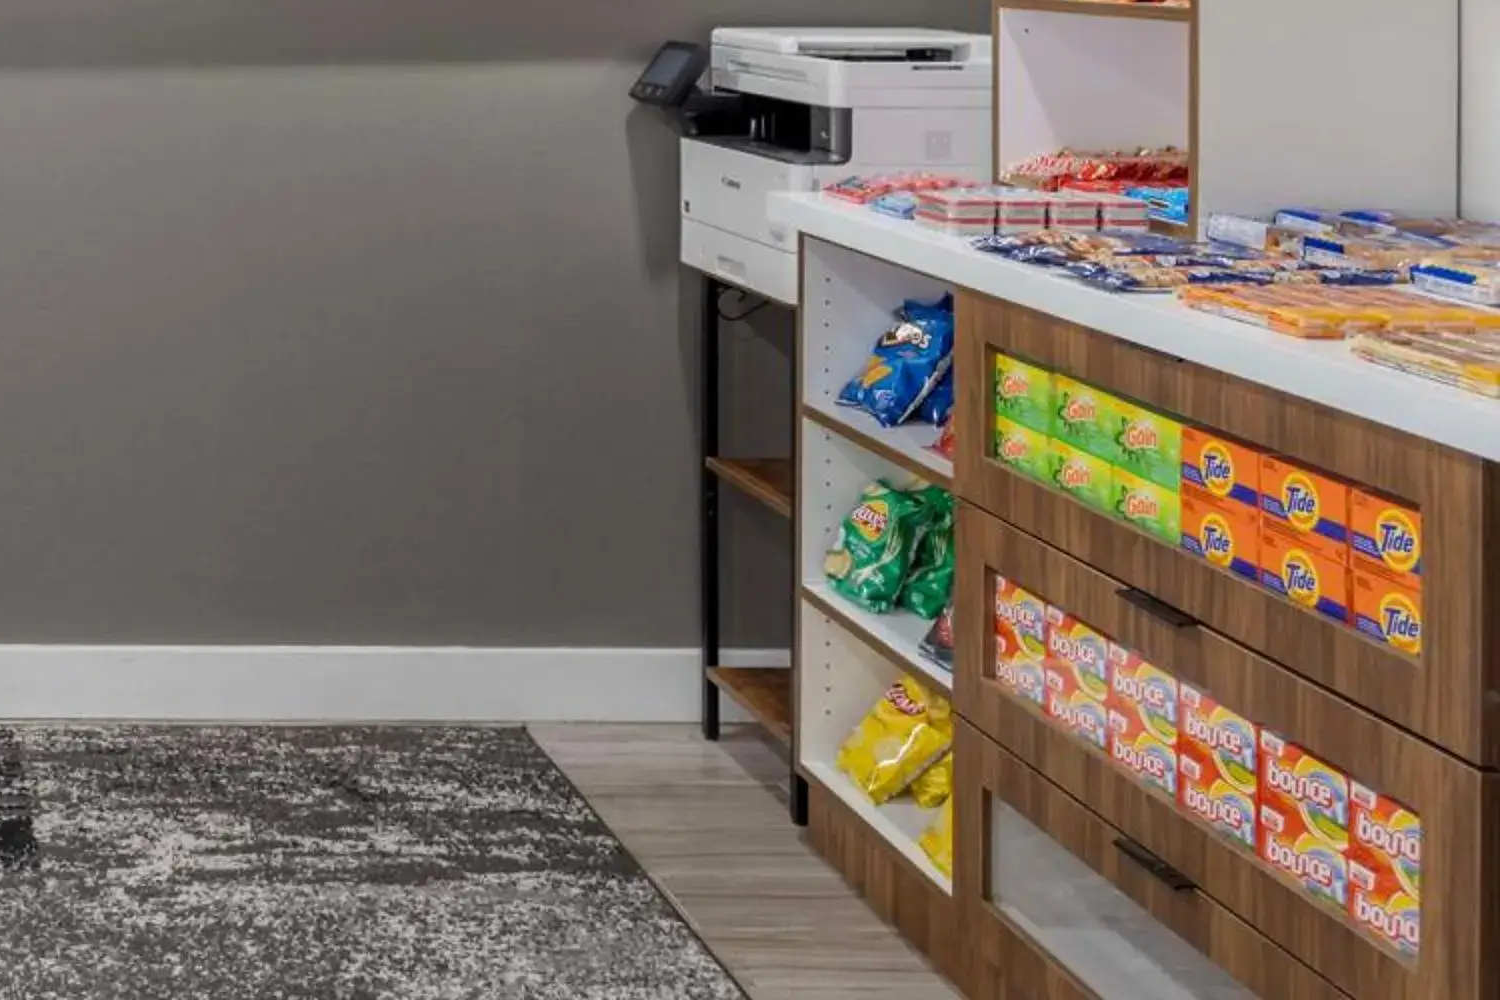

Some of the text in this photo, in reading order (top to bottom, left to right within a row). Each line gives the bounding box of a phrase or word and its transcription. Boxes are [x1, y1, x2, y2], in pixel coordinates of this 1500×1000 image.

[1068, 398, 1096, 421] Gain
[1126, 424, 1157, 448] Gain
[1063, 463, 1091, 487] Gain
[1204, 455, 1231, 480] Tide
[1126, 493, 1157, 517] Gain
[1286, 486, 1315, 514] Tide
[1204, 526, 1231, 552] Tide
[1380, 523, 1416, 554] Tide
[1286, 563, 1316, 591] Tide
[1384, 607, 1420, 637] Tide
[1114, 666, 1165, 708] bounce
[1187, 711, 1242, 754] bounce
[1114, 738, 1165, 778] bounce
[1267, 756, 1333, 807] bounce
[1187, 781, 1243, 829] bounce
[1357, 808, 1420, 862] bounc
[1266, 835, 1333, 887] bounce
[1355, 892, 1420, 943] bounc
